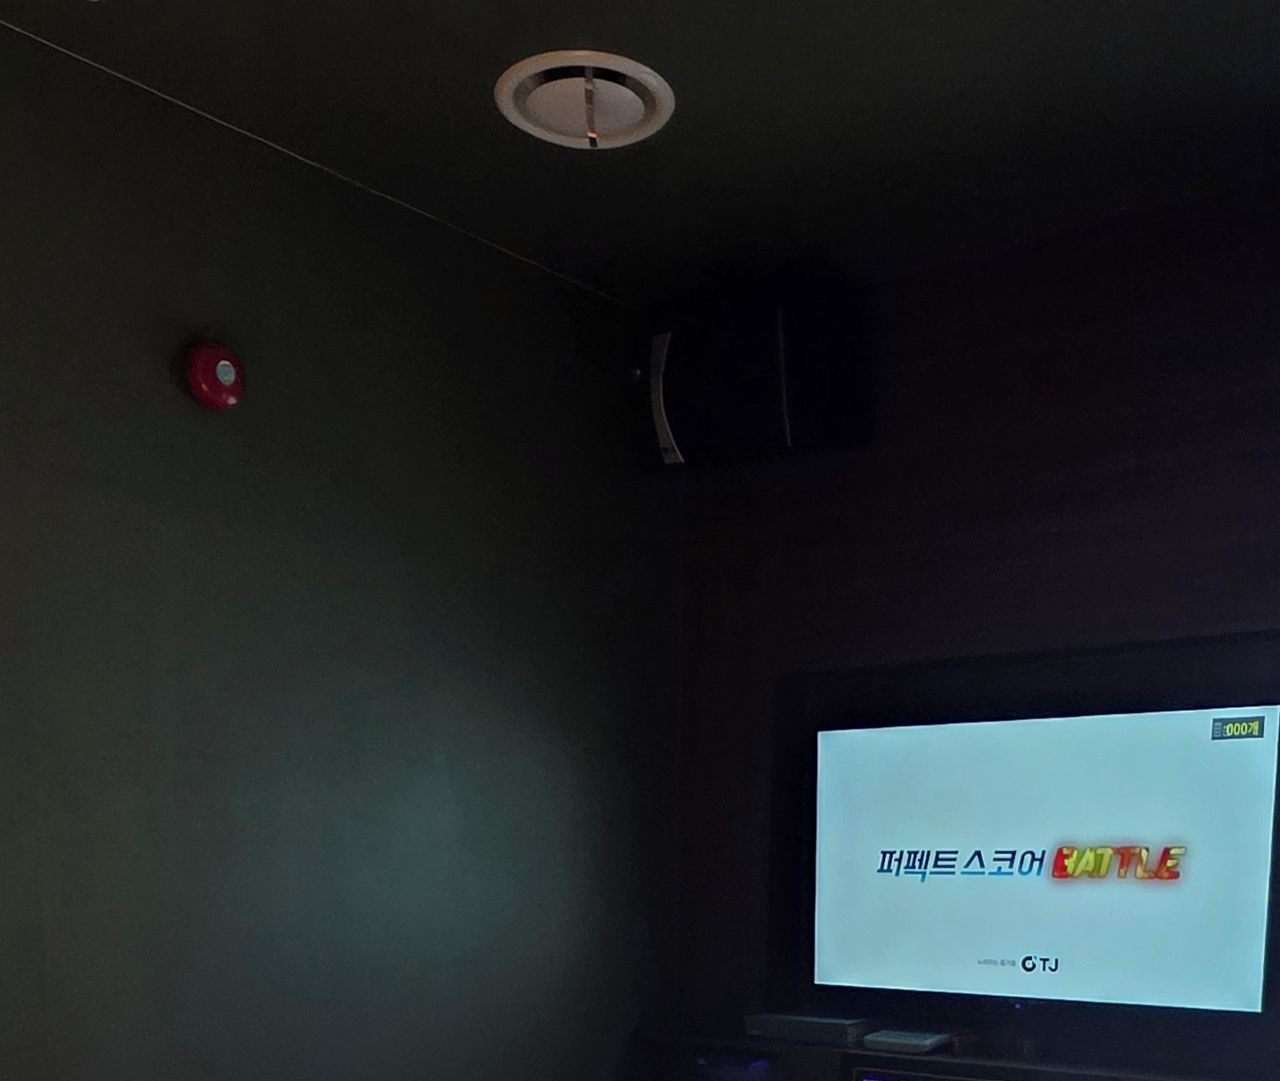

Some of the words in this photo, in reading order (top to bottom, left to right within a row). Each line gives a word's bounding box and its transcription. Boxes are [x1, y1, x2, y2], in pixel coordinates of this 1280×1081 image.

[877, 849, 1046, 882] 퍼펙트스코어
[1051, 845, 1186, 880] BATTLE
[1039, 957, 1059, 972] TJ
